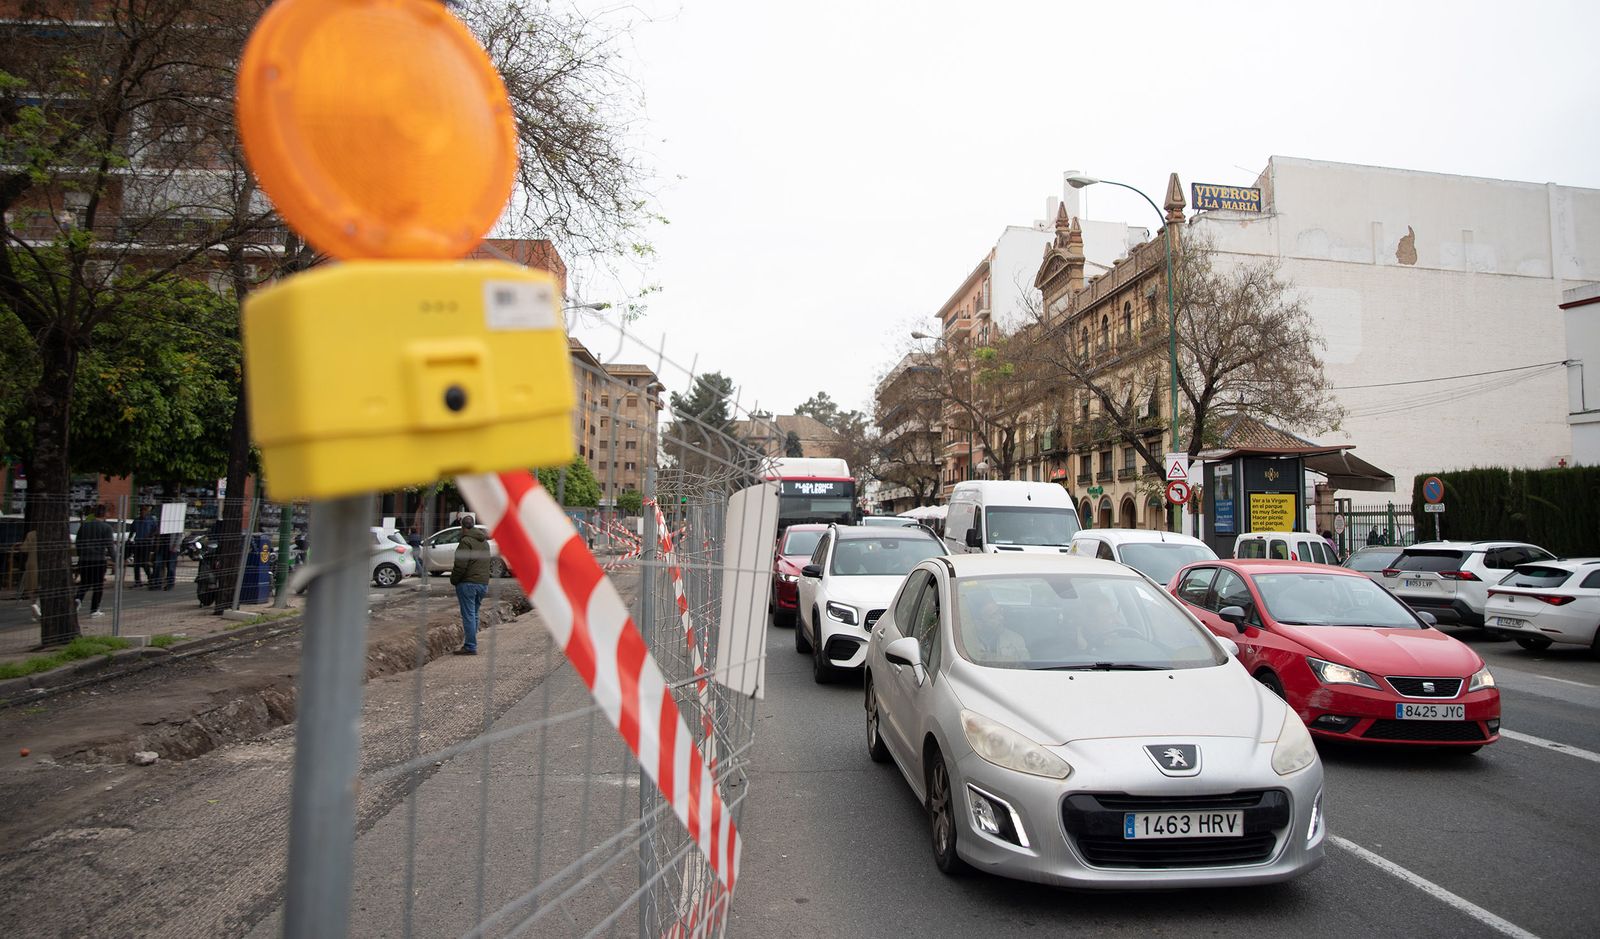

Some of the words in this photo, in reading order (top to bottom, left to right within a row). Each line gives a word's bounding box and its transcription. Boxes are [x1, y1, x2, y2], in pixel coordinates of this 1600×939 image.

[1195, 185, 1259, 202] VIVEROS
[1204, 198, 1219, 208] LA
[1221, 200, 1258, 211] MARIA
[1405, 705, 1438, 718] 8425
[1441, 706, 1463, 718] JYC
[1143, 815, 1191, 835] 1463
[1199, 813, 1238, 833] HRV
